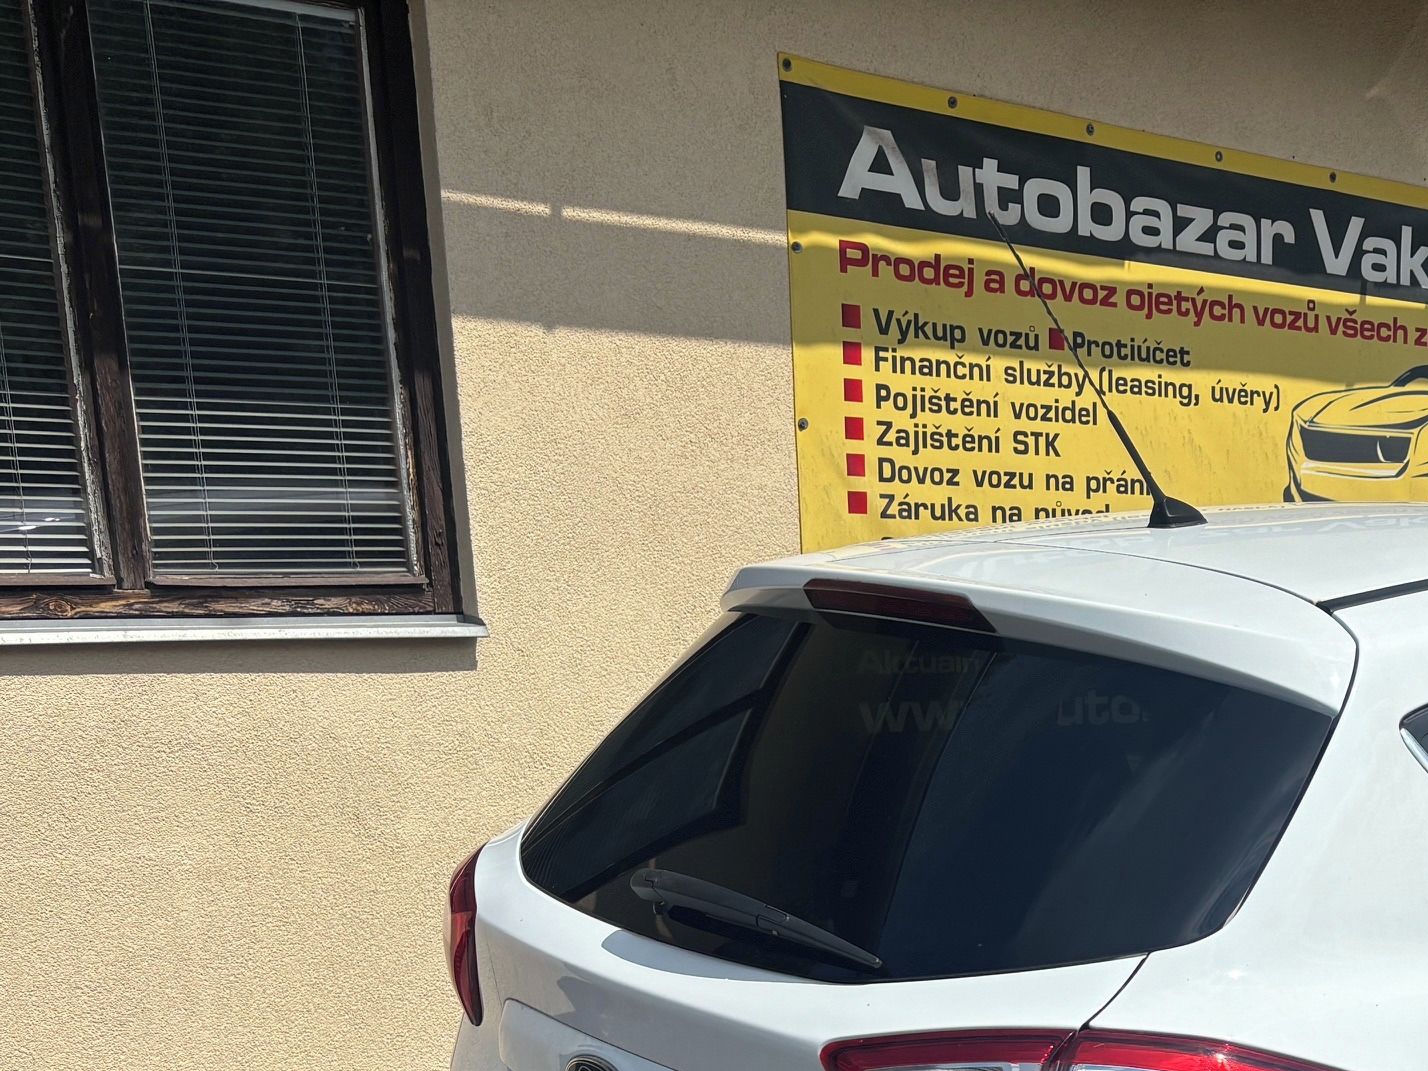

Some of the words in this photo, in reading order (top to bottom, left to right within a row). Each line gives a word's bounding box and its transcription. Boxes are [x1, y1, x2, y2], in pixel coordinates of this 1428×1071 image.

[837, 125, 1296, 266] Autobazar
[838, 239, 975, 298] Prodej
[983, 269, 1006, 294] a
[1014, 267, 1118, 308] dovoz
[1125, 283, 1246, 328] ojetých
[1252, 300, 1320, 334] vozů
[1325, 308, 1409, 345] všech
[872, 307, 967, 350] Výkup
[977, 325, 1040, 352] vozů
[1072, 331, 1192, 367] Protiúčet
[874, 346, 992, 382] Finanční
[1003, 360, 1088, 396] služby
[1098, 366, 1200, 407] (leasing,
[1211, 378, 1281, 413] úvěry)
[874, 382, 1000, 420] Pojištění
[1010, 398, 1098, 426] vozidel
[876, 420, 1001, 456] Zajištění
[1012, 430, 1062, 458] STK
[877, 457, 960, 487] Dovoz
[972, 468, 1034, 491] vozu
[1045, 472, 1075, 493] na
[879, 493, 980, 523] Záruka
[991, 504, 1023, 524] na
